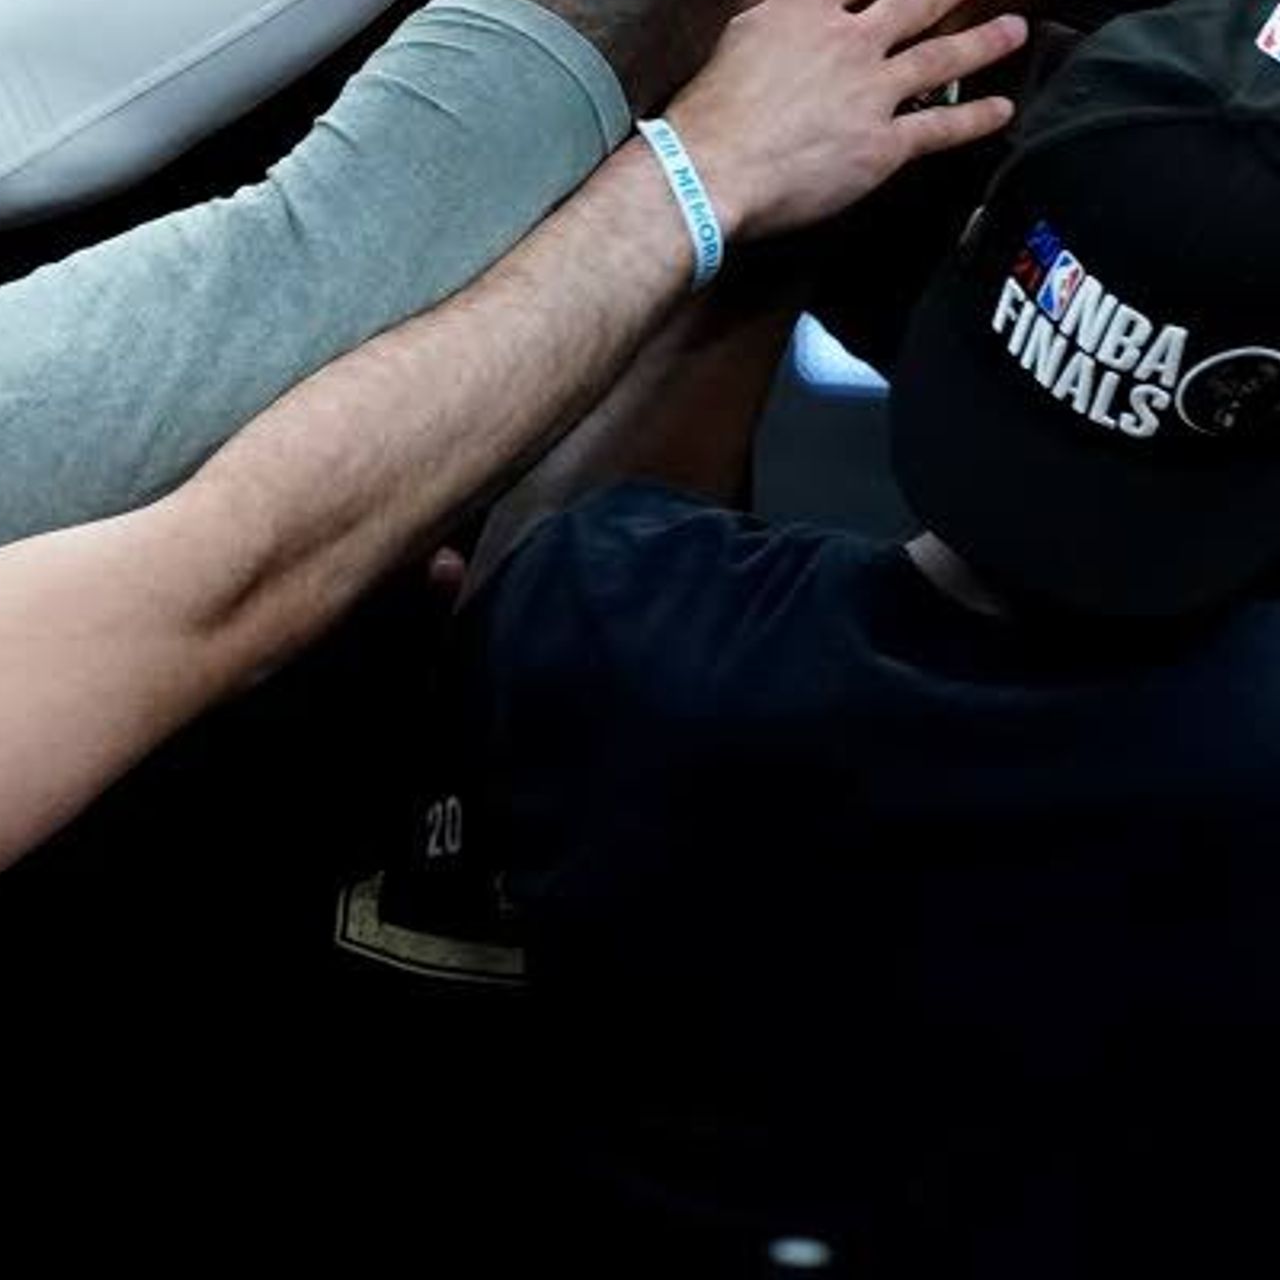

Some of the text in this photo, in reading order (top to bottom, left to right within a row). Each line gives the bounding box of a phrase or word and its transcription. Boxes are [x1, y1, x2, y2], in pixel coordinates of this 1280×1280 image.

[674, 165, 719, 273] MEMORI
[992, 276, 1171, 438] FINALS
[1059, 275, 1189, 388] NBA
[426, 795, 463, 858] 20
